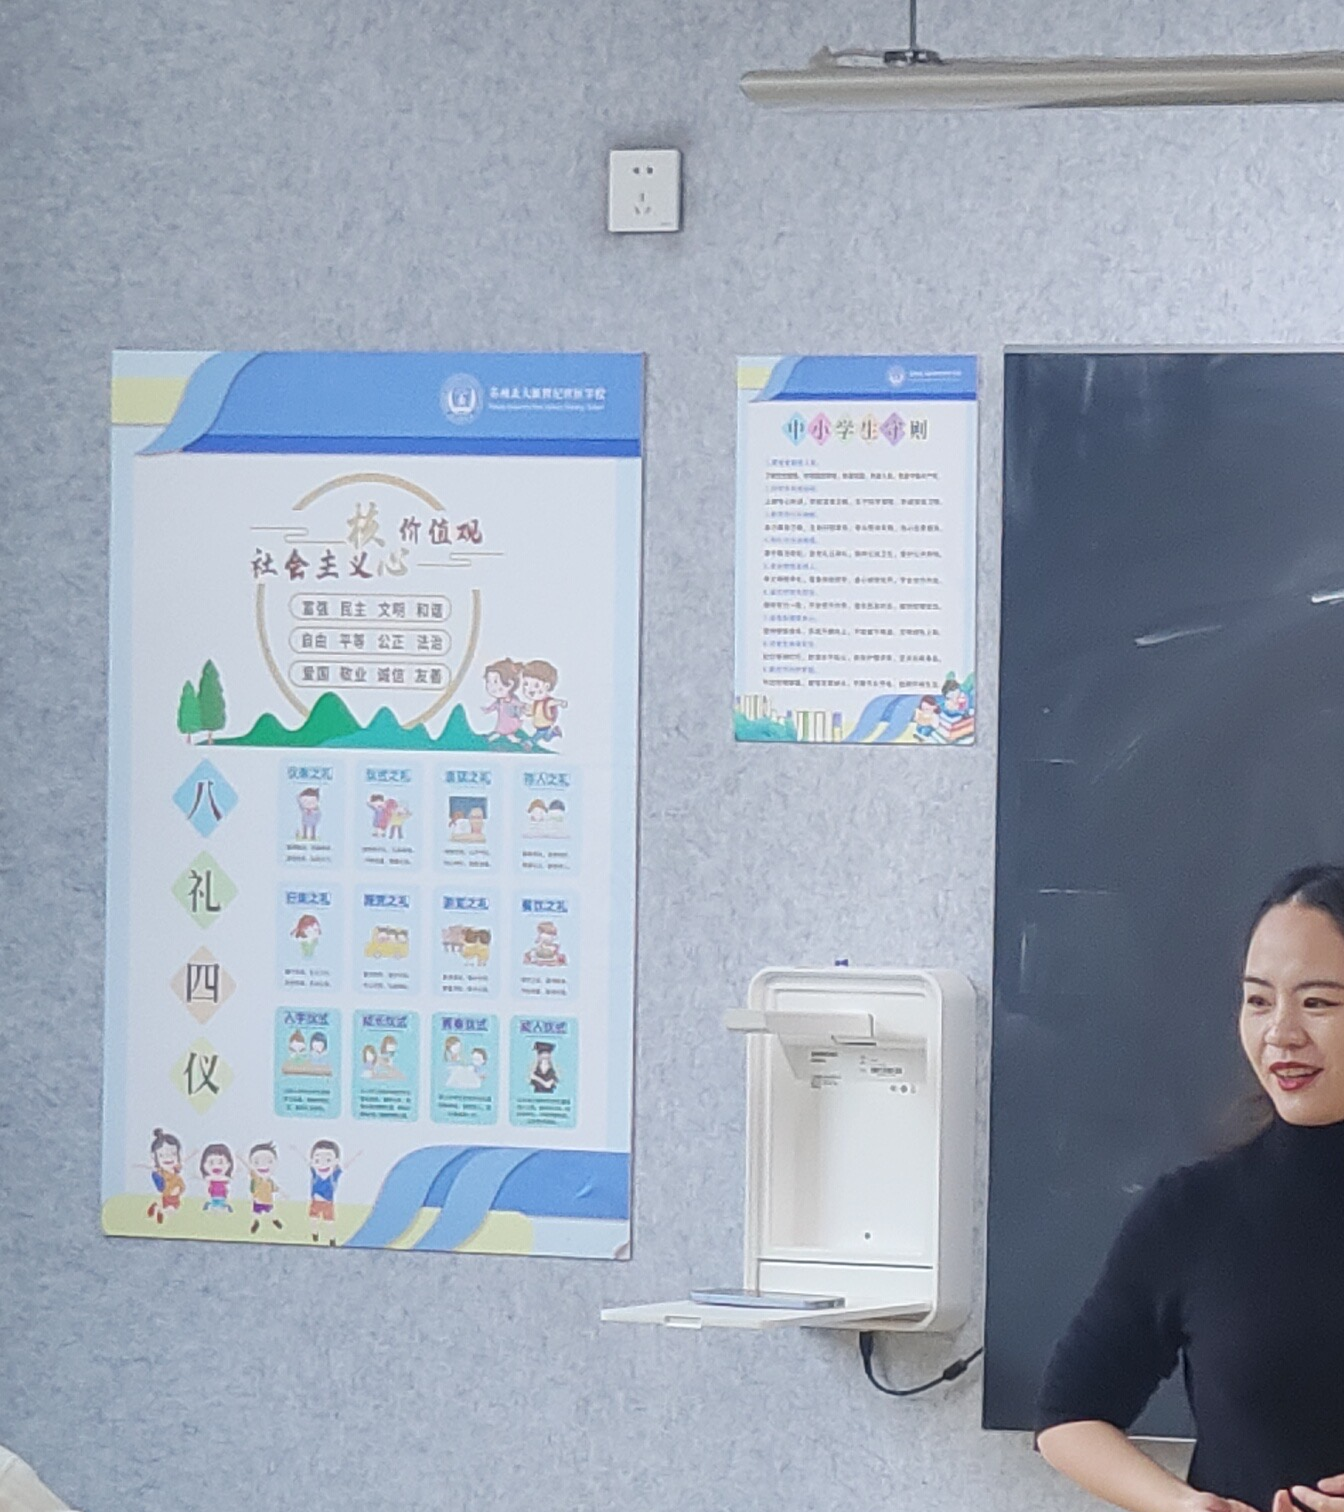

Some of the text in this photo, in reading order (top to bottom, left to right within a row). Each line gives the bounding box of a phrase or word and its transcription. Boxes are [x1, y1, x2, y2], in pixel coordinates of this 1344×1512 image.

[788, 418, 928, 440] 中小学生守则
[251, 548, 373, 580] 社会主义
[399, 516, 483, 545] 价值观
[340, 601, 367, 617] 民主
[378, 602, 405, 618] 文明
[339, 633, 365, 649] 平等
[378, 634, 404, 650] 公正
[416, 635, 443, 650] 法治
[377, 667, 404, 683] 诚信
[415, 668, 442, 683] 友善
[185, 780, 222, 1095] 八礼四仪
